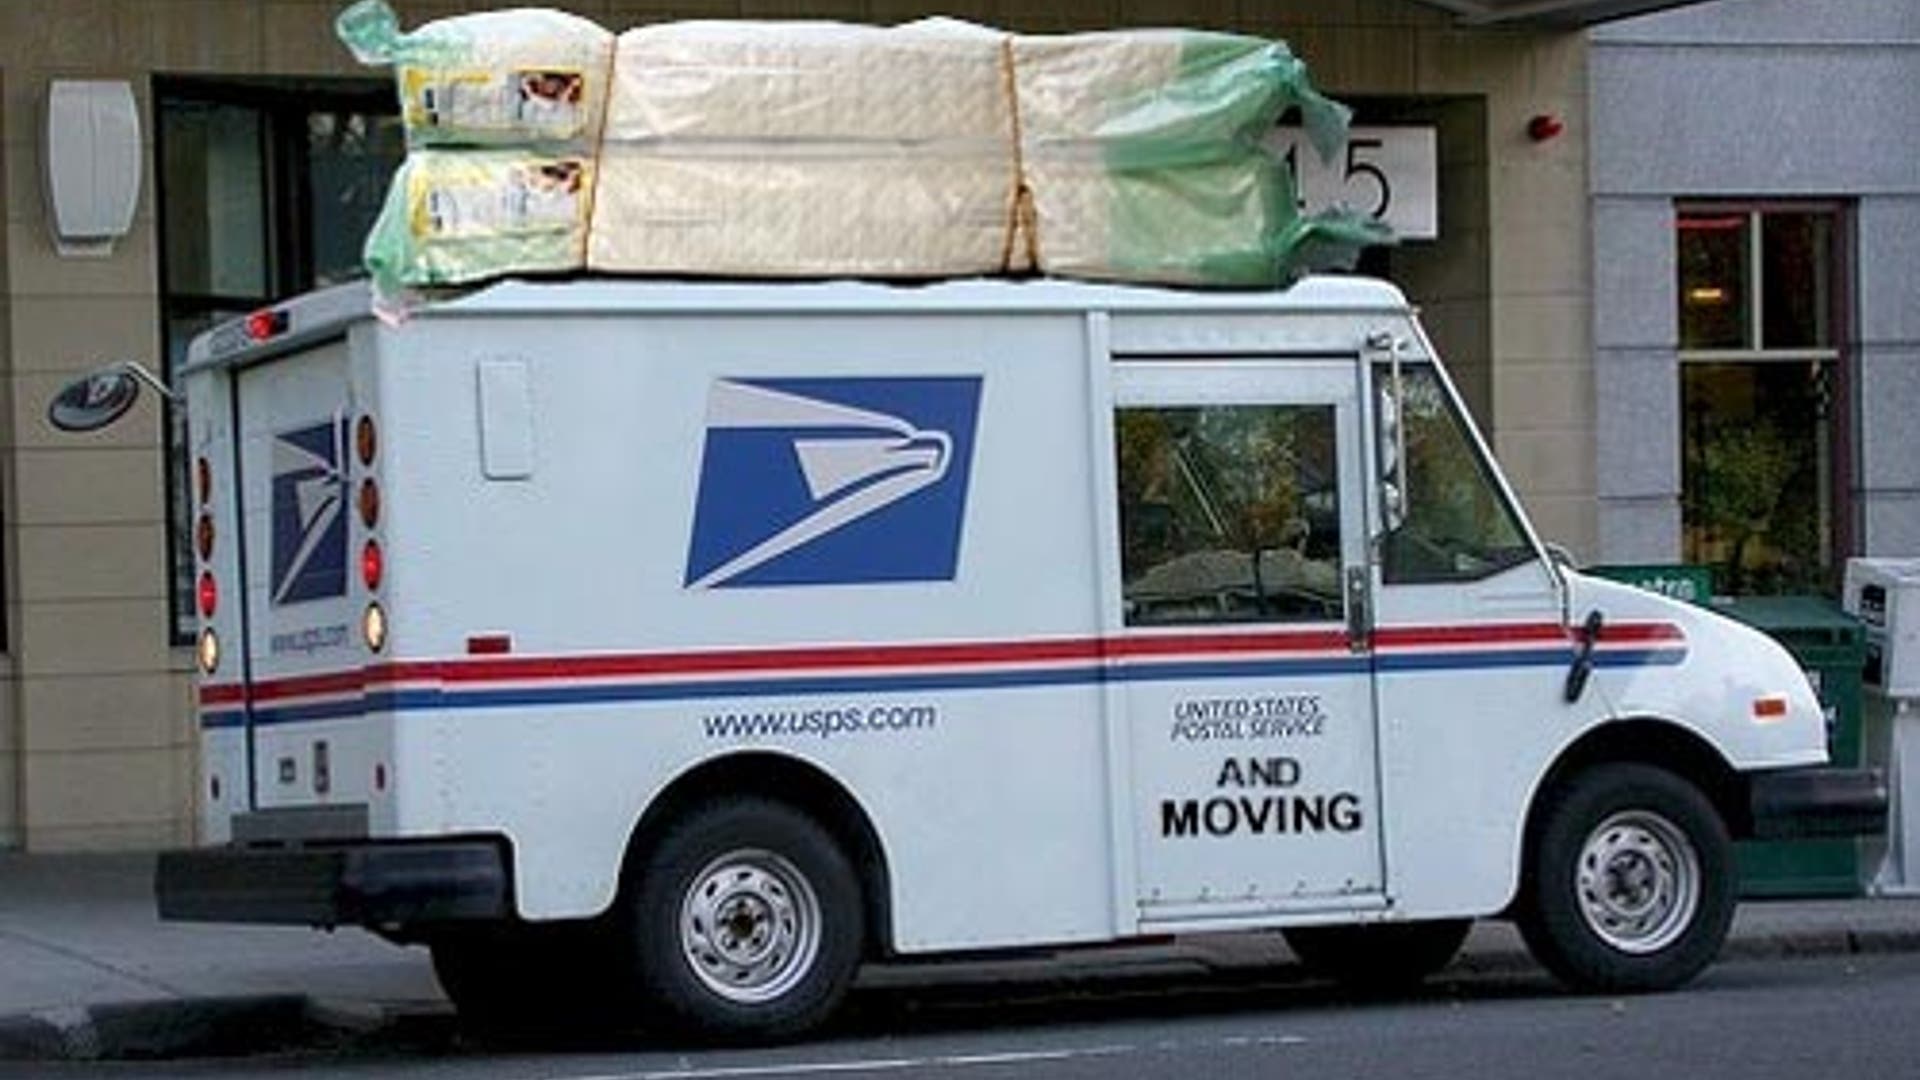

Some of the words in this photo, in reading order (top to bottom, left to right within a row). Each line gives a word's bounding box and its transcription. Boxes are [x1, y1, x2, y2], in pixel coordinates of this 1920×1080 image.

[704, 706, 936, 739] www.usps.com
[1174, 699, 1249, 720] UNITED
[1252, 696, 1321, 717] STATES
[1170, 719, 1245, 741] POSTAL
[1250, 714, 1327, 738] SERVICE
[1217, 757, 1302, 788] AND
[1162, 793, 1363, 838] MOVING
